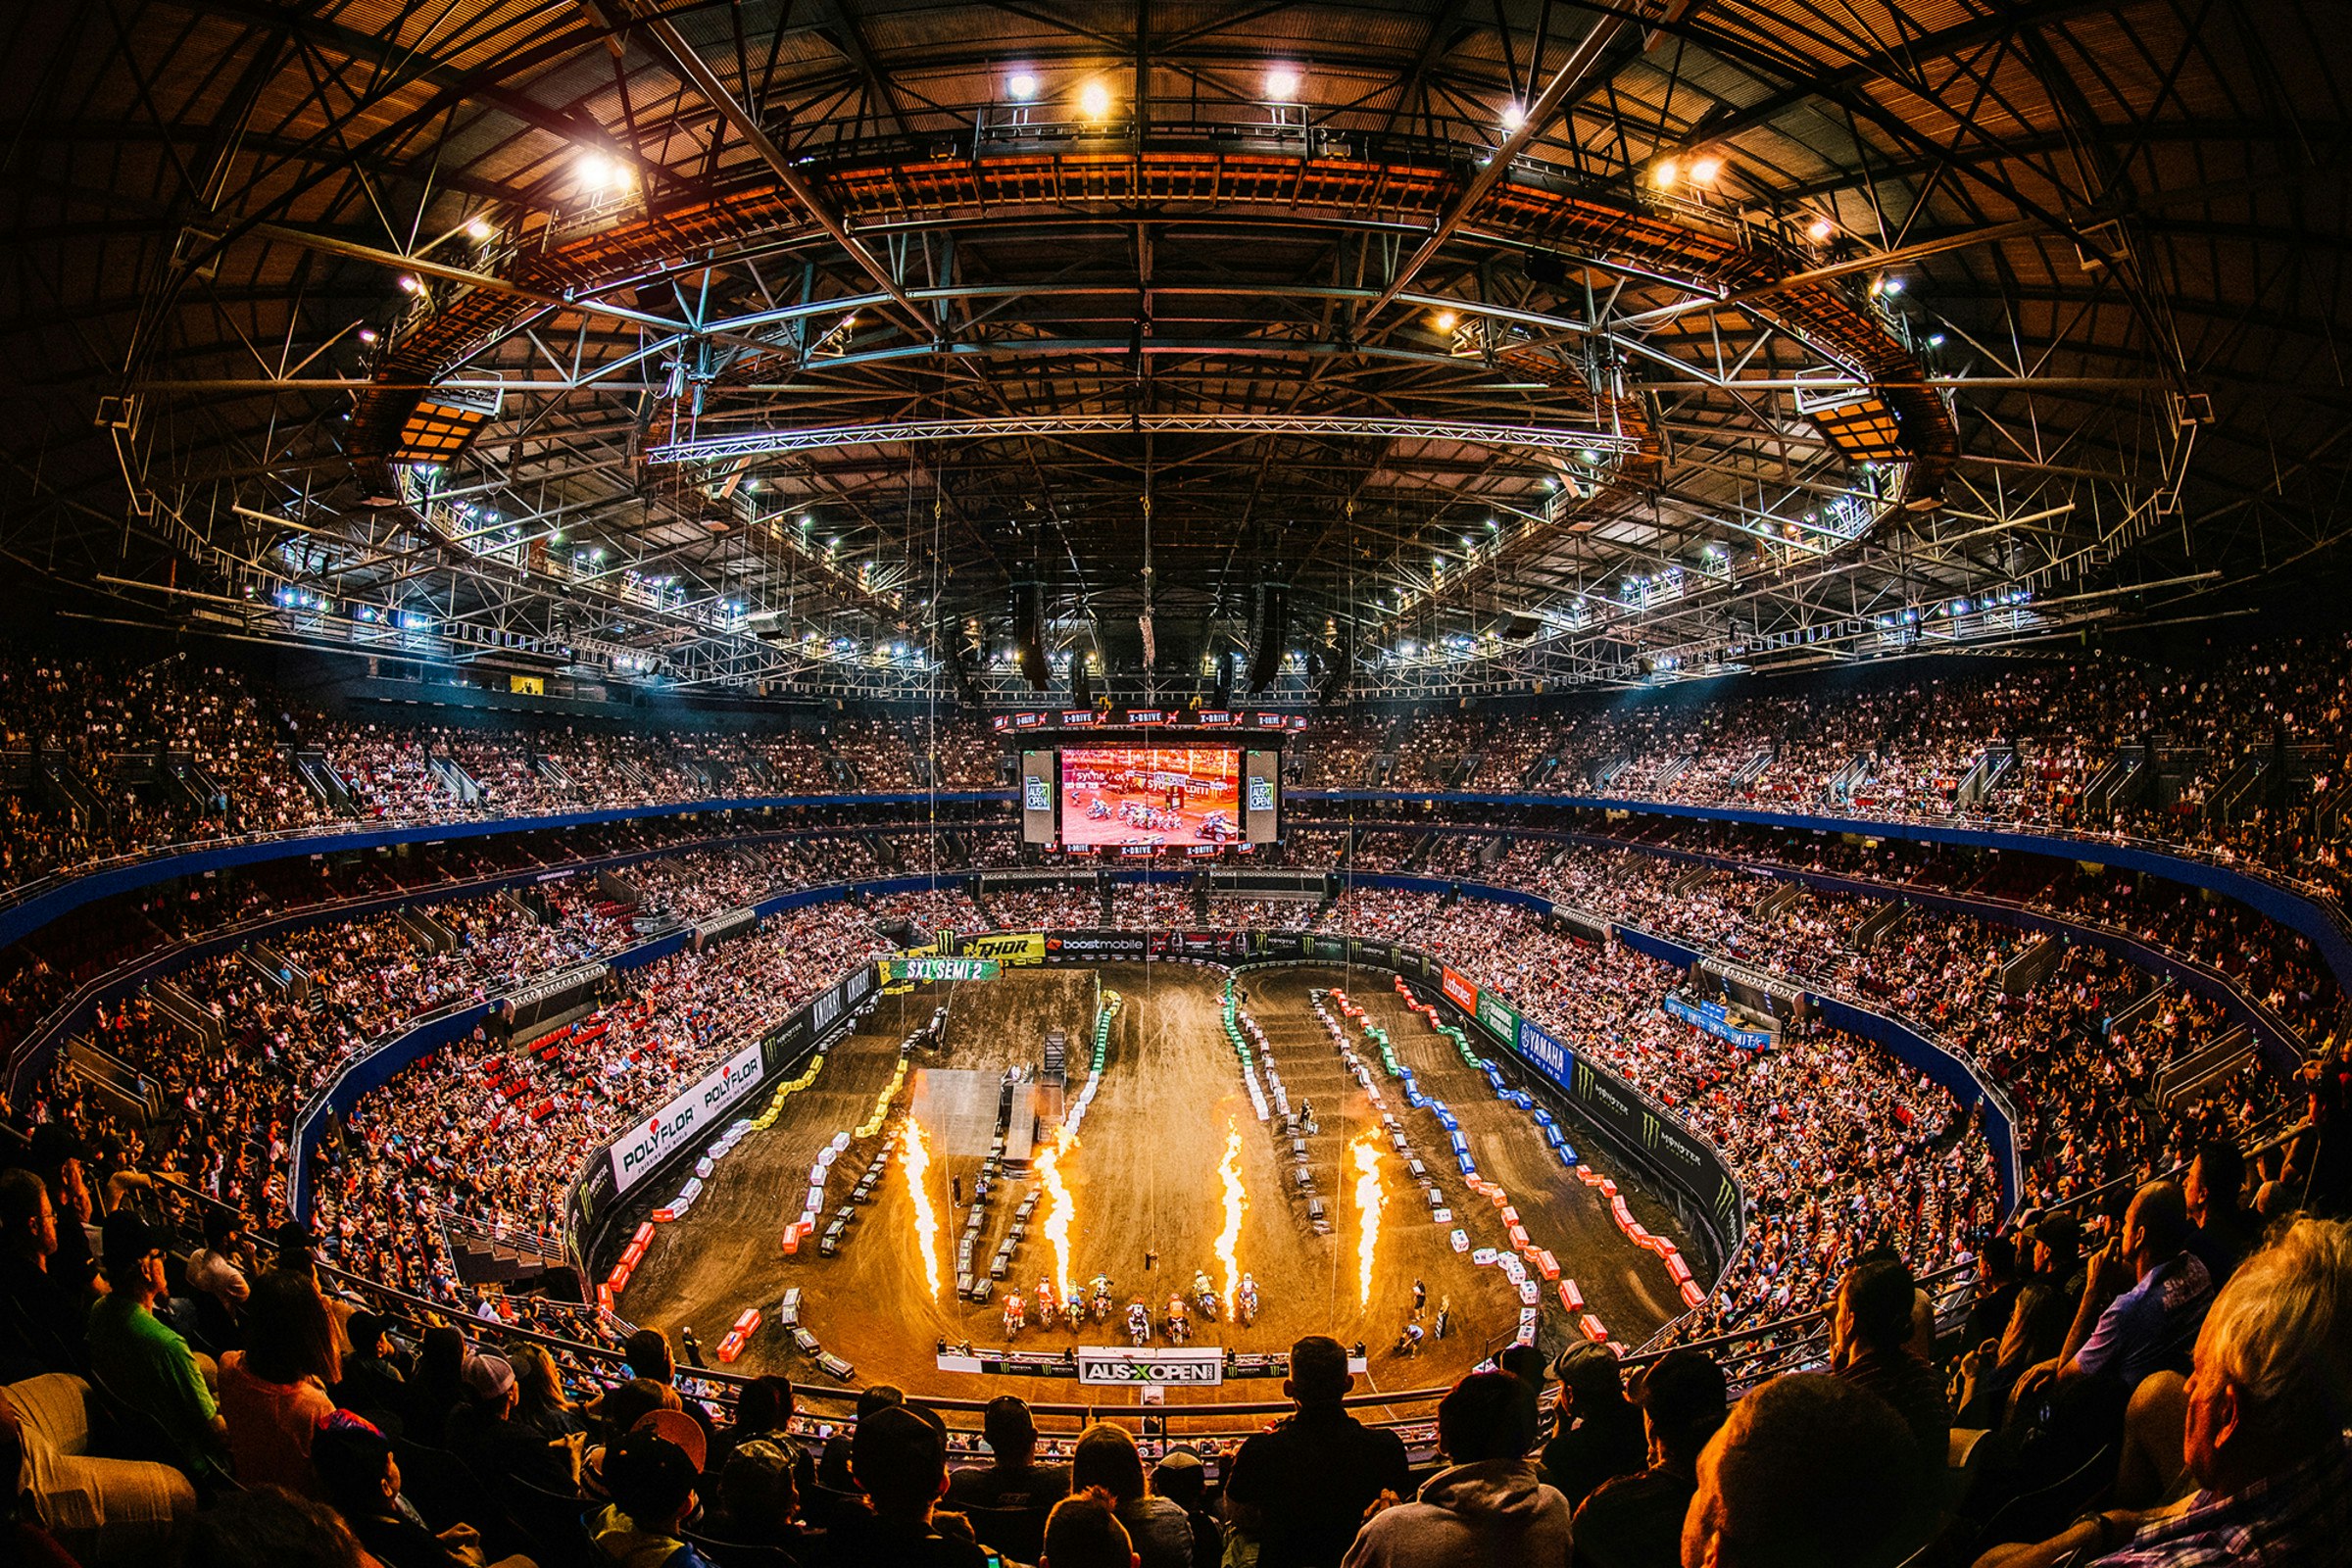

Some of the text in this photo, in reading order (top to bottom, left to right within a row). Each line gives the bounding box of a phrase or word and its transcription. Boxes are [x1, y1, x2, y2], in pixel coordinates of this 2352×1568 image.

[1063, 712, 1092, 723] X-DRIVE
[1129, 712, 1161, 723] X-DRIVE
[1200, 713, 1229, 723] X-DRIVE
[1121, 846, 1152, 855] X-DRIVE
[1187, 845, 1214, 855] X-DRIVE
[979, 940, 1028, 956] THOR
[906, 961, 982, 979] SX1 SEMI 2
[1529, 1029, 1564, 1074] YAMAHA
[1523, 1049, 1560, 1081] RACING
[705, 1057, 759, 1108] POLYFLOR
[1595, 1083, 1629, 1116] MONSTER
[623, 1106, 694, 1173] POLYFLOR
[1661, 1131, 1701, 1166] MONSTER
